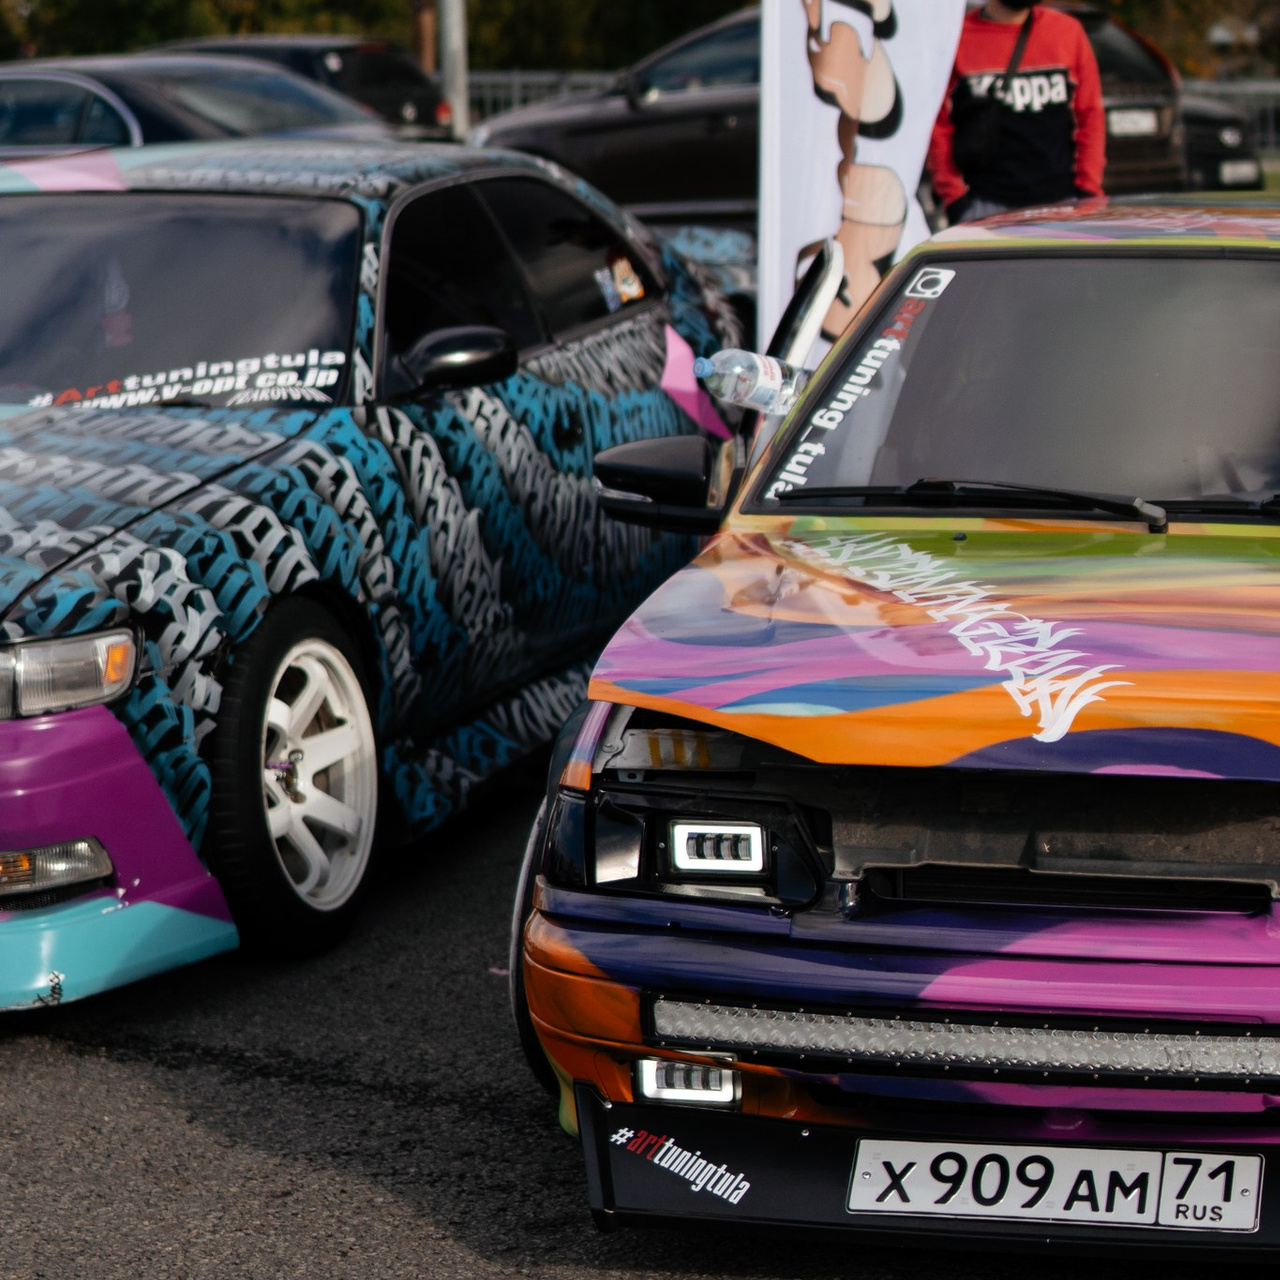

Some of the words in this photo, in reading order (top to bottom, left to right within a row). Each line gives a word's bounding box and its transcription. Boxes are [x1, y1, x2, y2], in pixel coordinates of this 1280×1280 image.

[610, 1127, 751, 1205] #arttuningtula
[1173, 1157, 1236, 1203] 71
[1175, 1204, 1223, 1221] RUS
